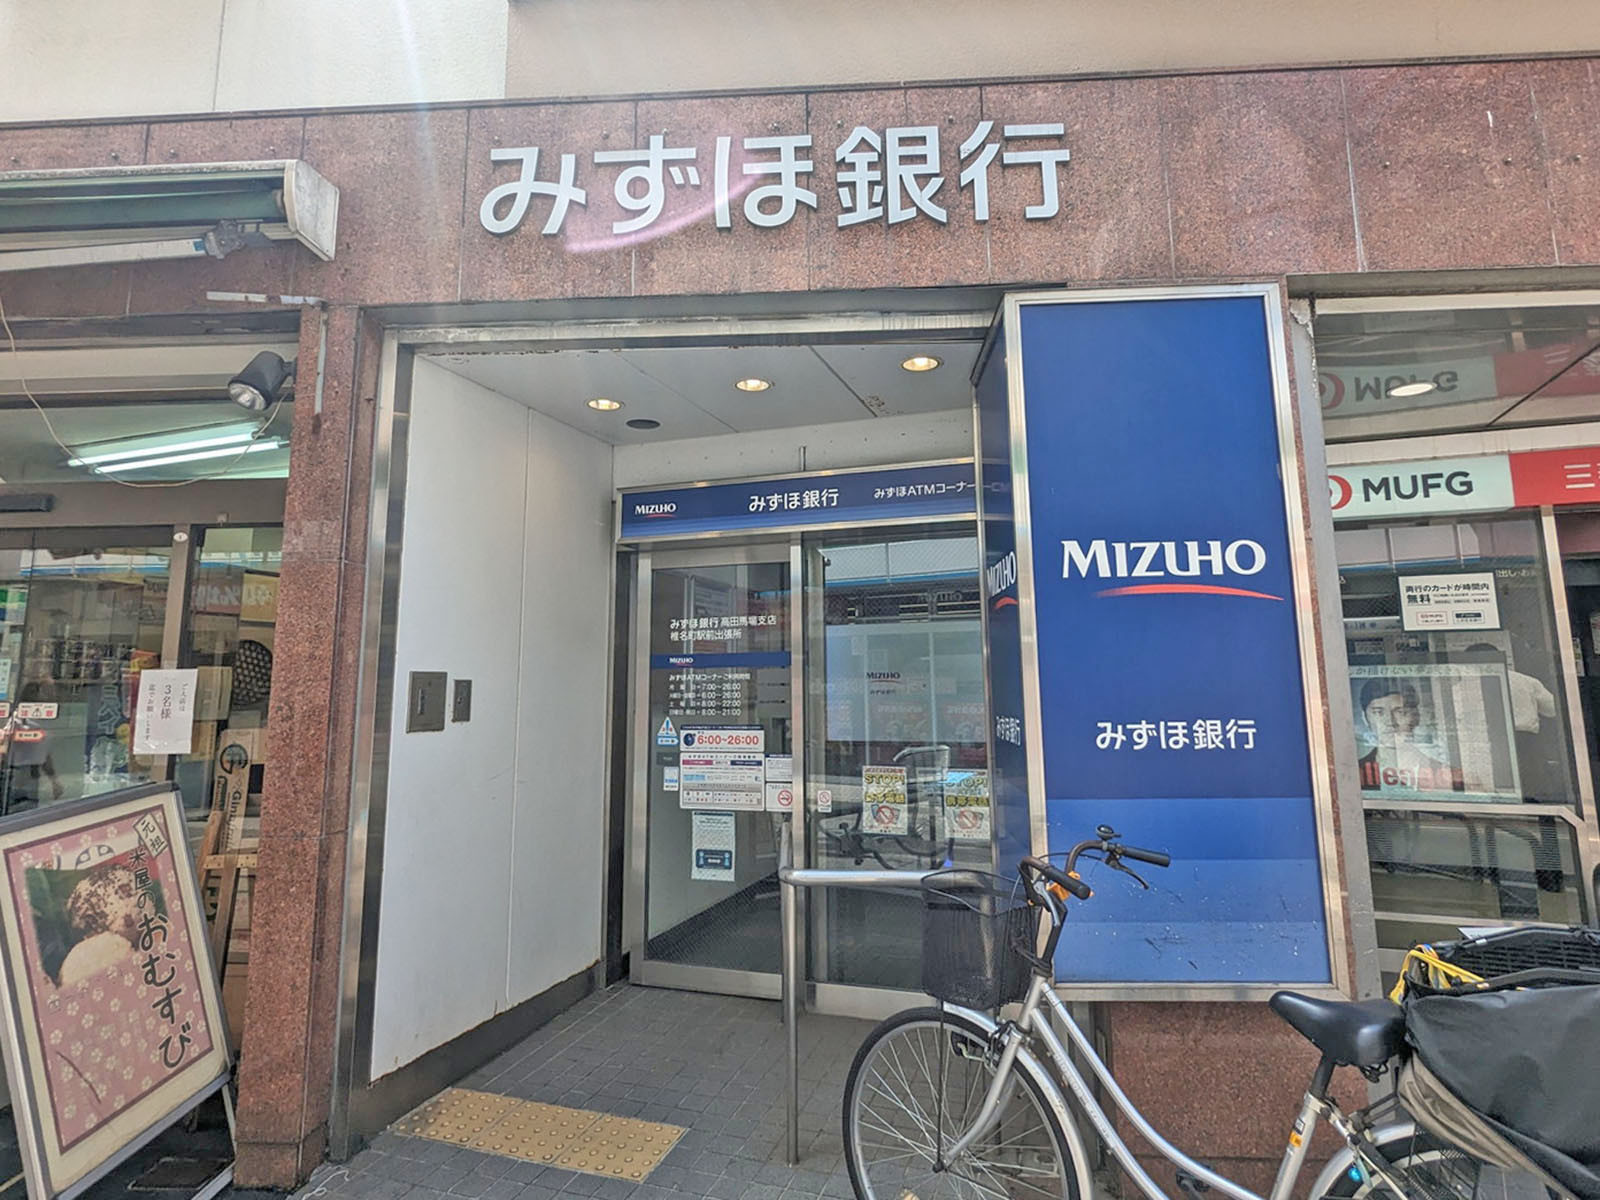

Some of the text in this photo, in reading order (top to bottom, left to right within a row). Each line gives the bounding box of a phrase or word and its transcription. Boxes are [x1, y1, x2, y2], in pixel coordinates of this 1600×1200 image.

[479, 120, 1071, 235] みずほ銀行
[873, 483, 975, 499] みずほATMコーナー
[1361, 471, 1474, 502] MUFG
[1564, 462, 1600, 490] 三
[634, 503, 677, 516] MIZUHO
[748, 489, 839, 512] みずほ銀行
[986, 551, 1017, 598] MIZUHO
[1060, 539, 1267, 579] MIZUHO
[1095, 719, 1257, 750] みずほ銀行
[864, 774, 905, 785] STOP!
[141, 819, 166, 853] 元祖
